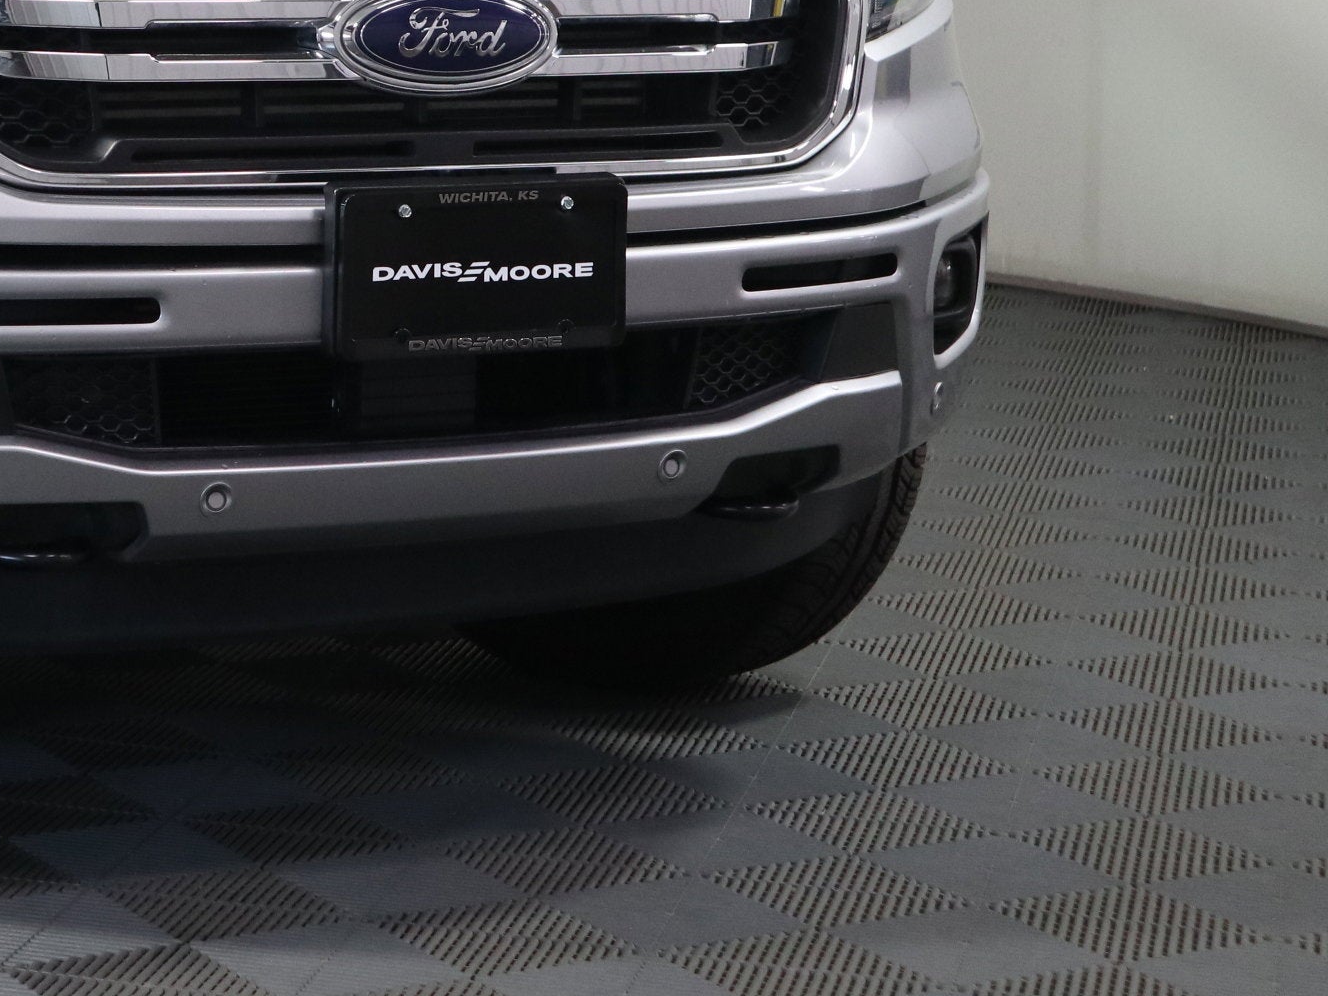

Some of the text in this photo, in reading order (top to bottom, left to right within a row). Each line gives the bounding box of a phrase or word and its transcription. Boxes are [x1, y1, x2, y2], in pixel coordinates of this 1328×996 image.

[398, 6, 508, 57] Ford
[517, 190, 540, 201] KS
[372, 262, 594, 283] DAVIS MOORE
[408, 335, 563, 352] DAVIS MOORE
